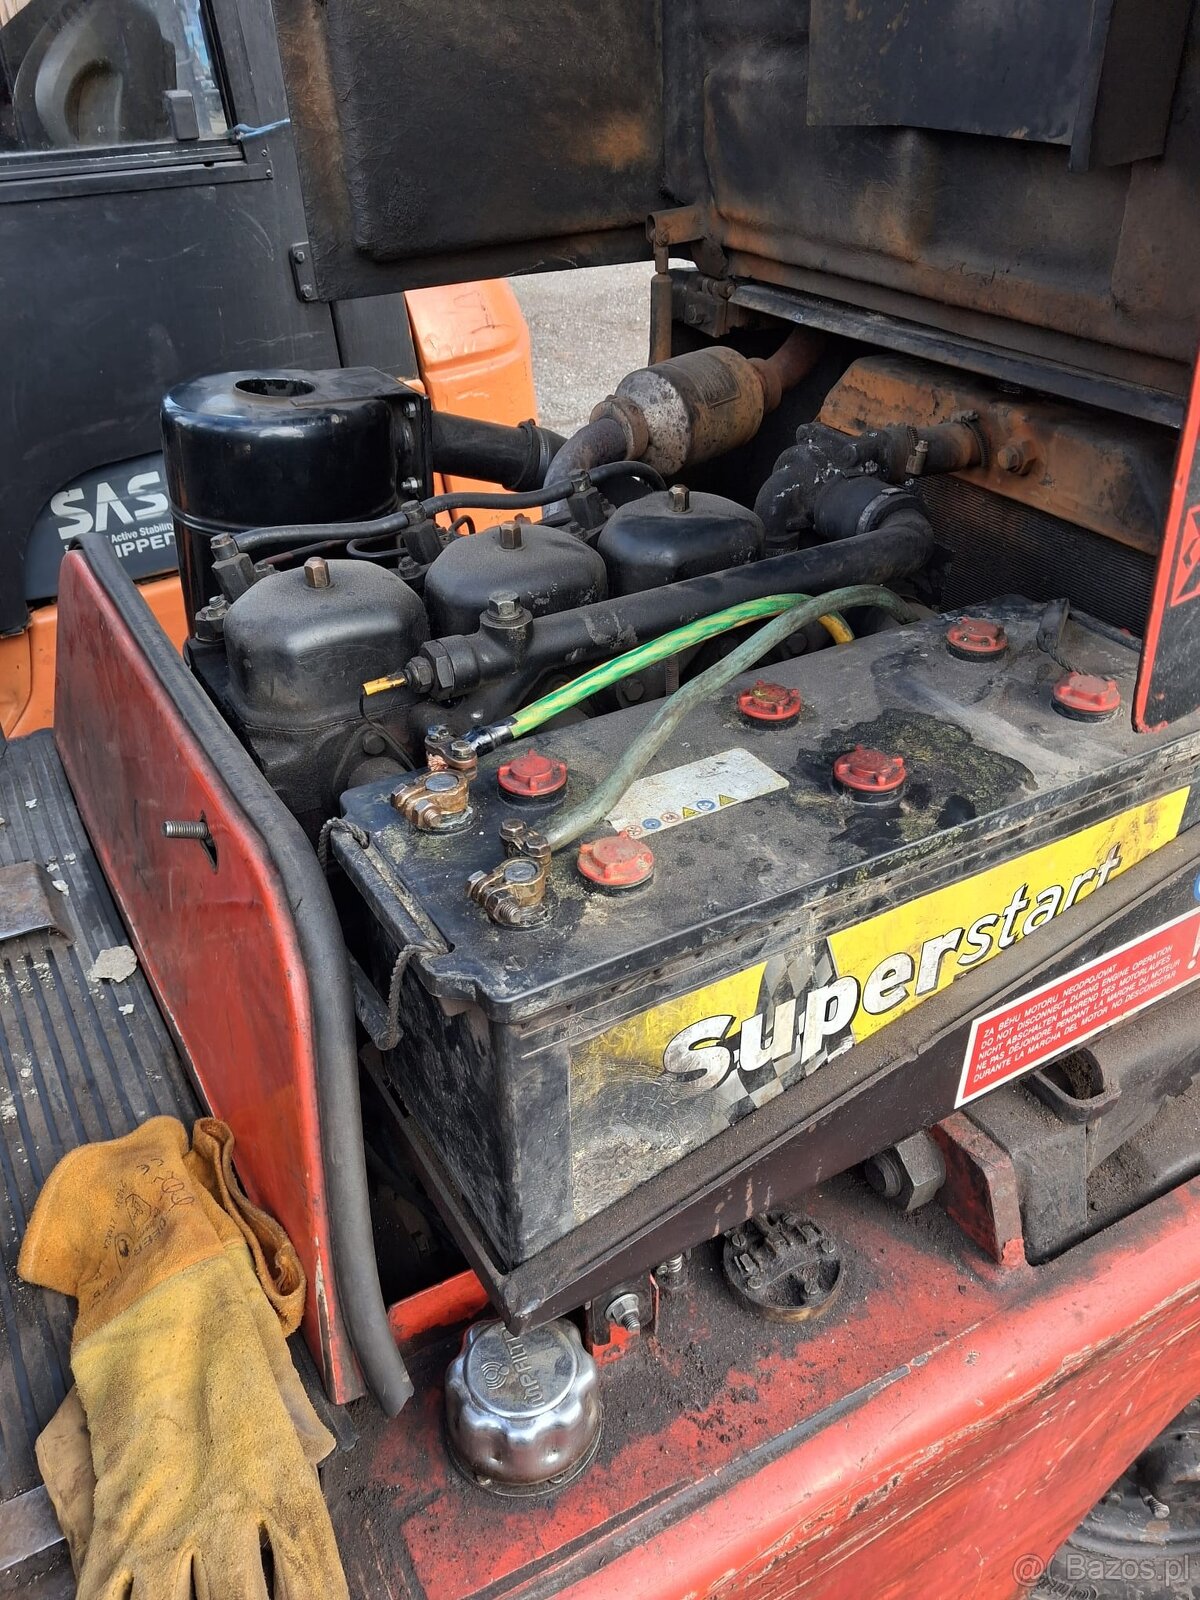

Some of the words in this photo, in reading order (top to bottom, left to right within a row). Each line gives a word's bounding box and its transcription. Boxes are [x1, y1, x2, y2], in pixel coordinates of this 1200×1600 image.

[51, 471, 168, 540] SAS
[111, 530, 138, 543] Active
[139, 522, 174, 536] Stability
[664, 843, 1122, 1089] Superstart
[976, 1060, 987, 1071] NE
[989, 1051, 1005, 1065] PAS
[1056, 1007, 1090, 1030] PENDANT
[1094, 999, 1104, 1009] LA
[1106, 984, 1136, 1004] MARCHE
[1138, 977, 1149, 988] DU
[1151, 959, 1180, 979] MOTEUR
[979, 1043, 1003, 1060] NICHT
[1006, 1015, 1058, 1047] ABSCHALTEN
[1101, 985, 1116, 997] DES
[1119, 954, 1171, 987] MOTORLAUFES
[981, 1038, 993, 1049] DO
[996, 1027, 1014, 1041] NOT
[1017, 999, 1067, 1031] DISCONNECT
[1070, 983, 1099, 1003] DURING
[1102, 967, 1130, 986] ENGINE
[1132, 945, 1173, 970] OPERATION
[984, 1027, 994, 1038] ZA
[1024, 994, 1059, 1017] MOTORU
[1062, 964, 1117, 997] NEODPOJOVAT
[973, 1057, 1012, 1083] DURANTE
[1014, 1051, 1025, 1062] LA
[1027, 1031, 1061, 1055] MARCHA
[1063, 1023, 1078, 1035] DEL
[1081, 1006, 1108, 1027] MOTOR
[1111, 998, 1123, 1009] NO
[1124, 970, 1176, 1003] DESCONECTAR
